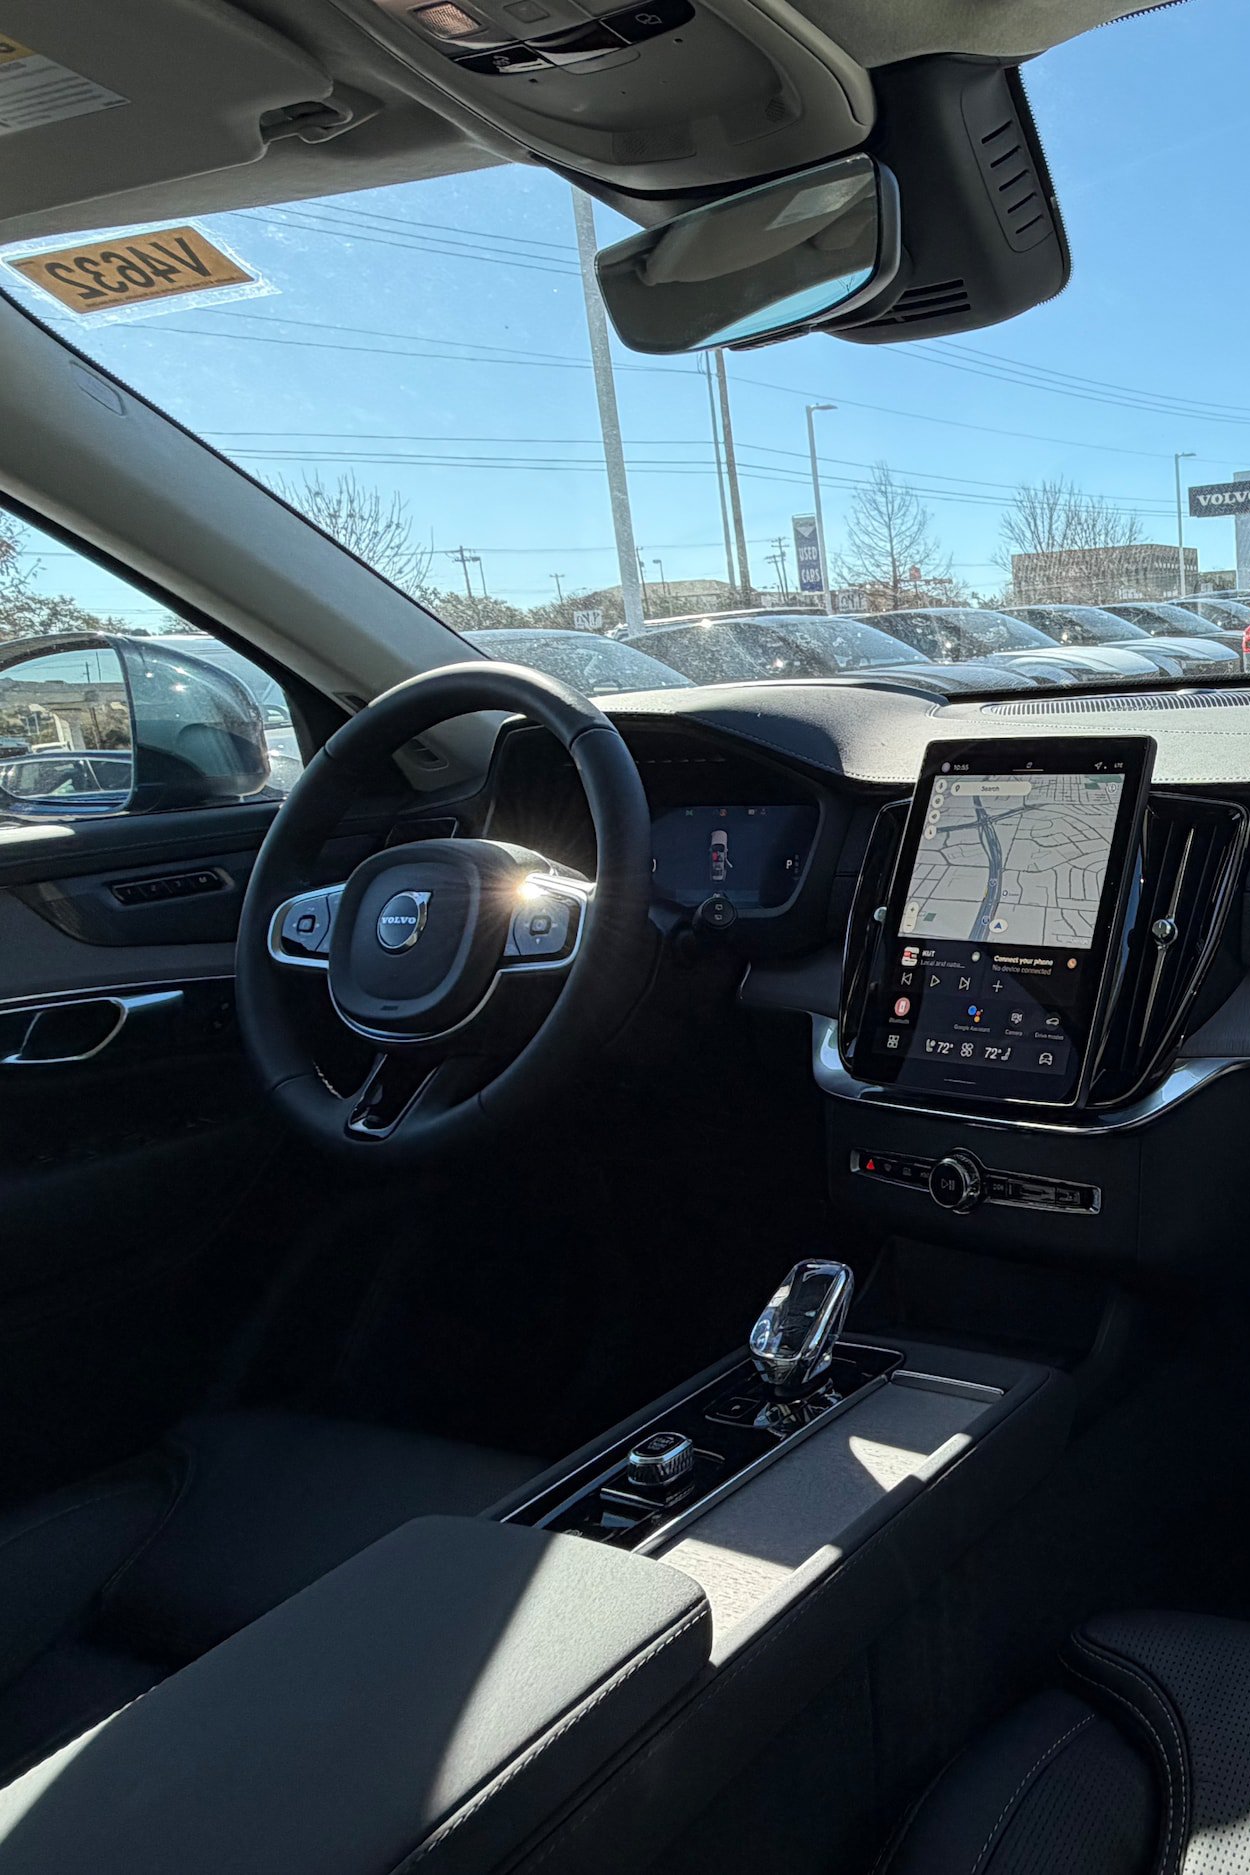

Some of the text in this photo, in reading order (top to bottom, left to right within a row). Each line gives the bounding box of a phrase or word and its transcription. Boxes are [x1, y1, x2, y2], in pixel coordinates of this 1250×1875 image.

[799, 547, 818, 561] USED
[801, 568, 821, 583] CARS
[786, 860, 793, 869] P
[994, 955, 1054, 966] Connect your phone
